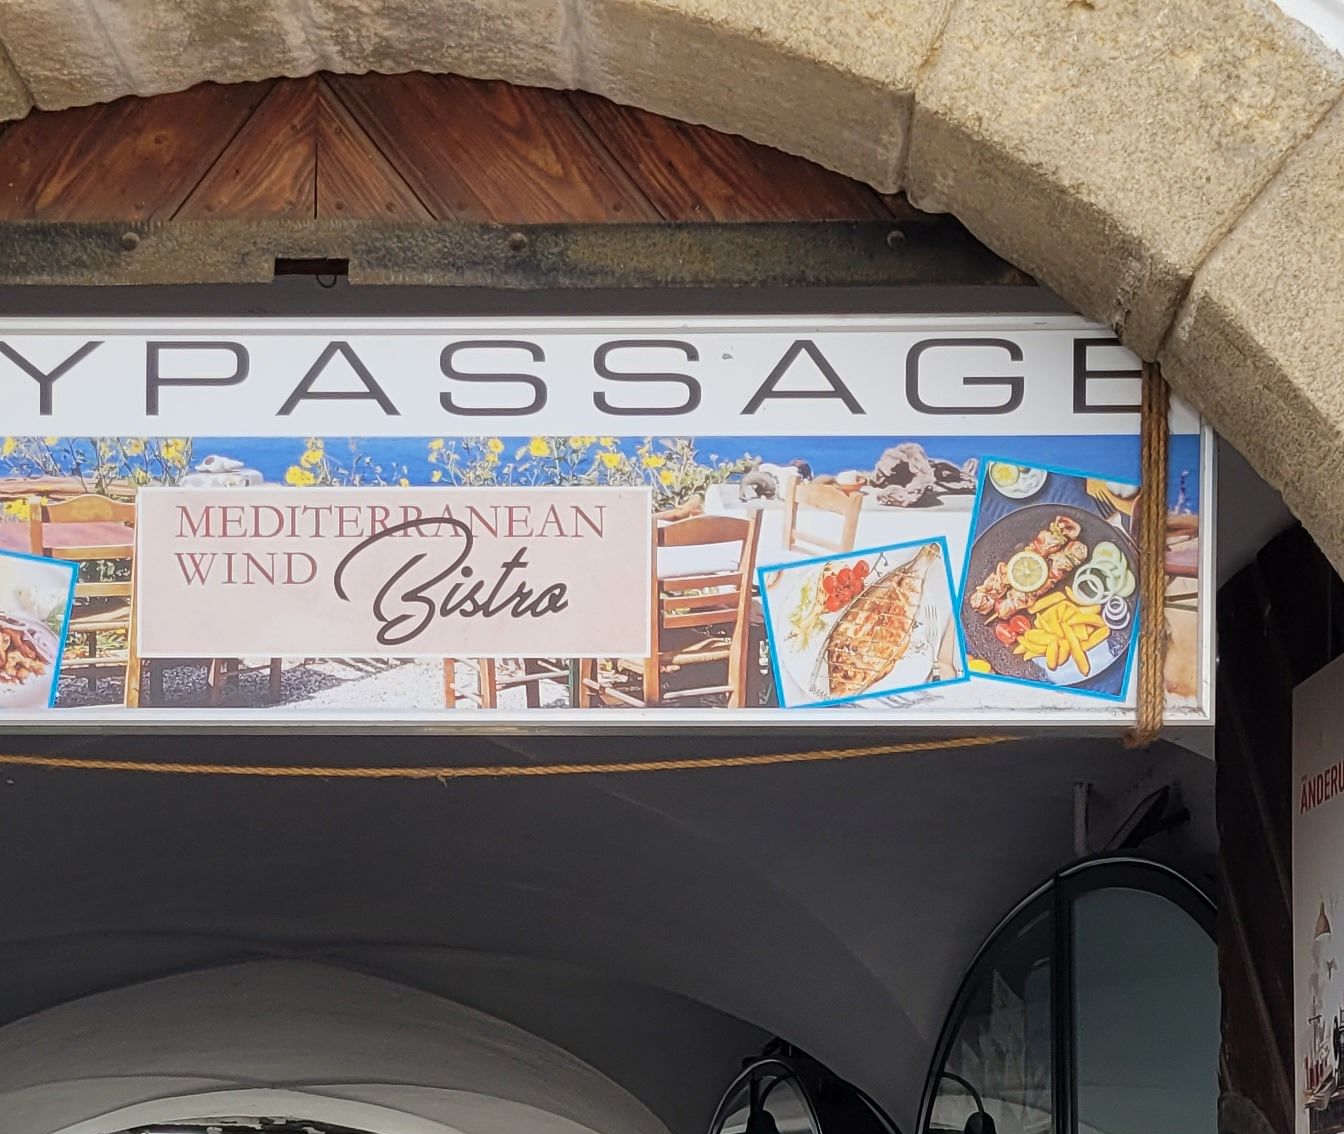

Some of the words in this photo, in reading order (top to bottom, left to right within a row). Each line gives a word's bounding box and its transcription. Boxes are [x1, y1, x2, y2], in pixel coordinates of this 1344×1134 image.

[174, 504, 607, 540] MEDITERRANEAN
[174, 551, 318, 586] WIND
[333, 516, 569, 646] Bistro
